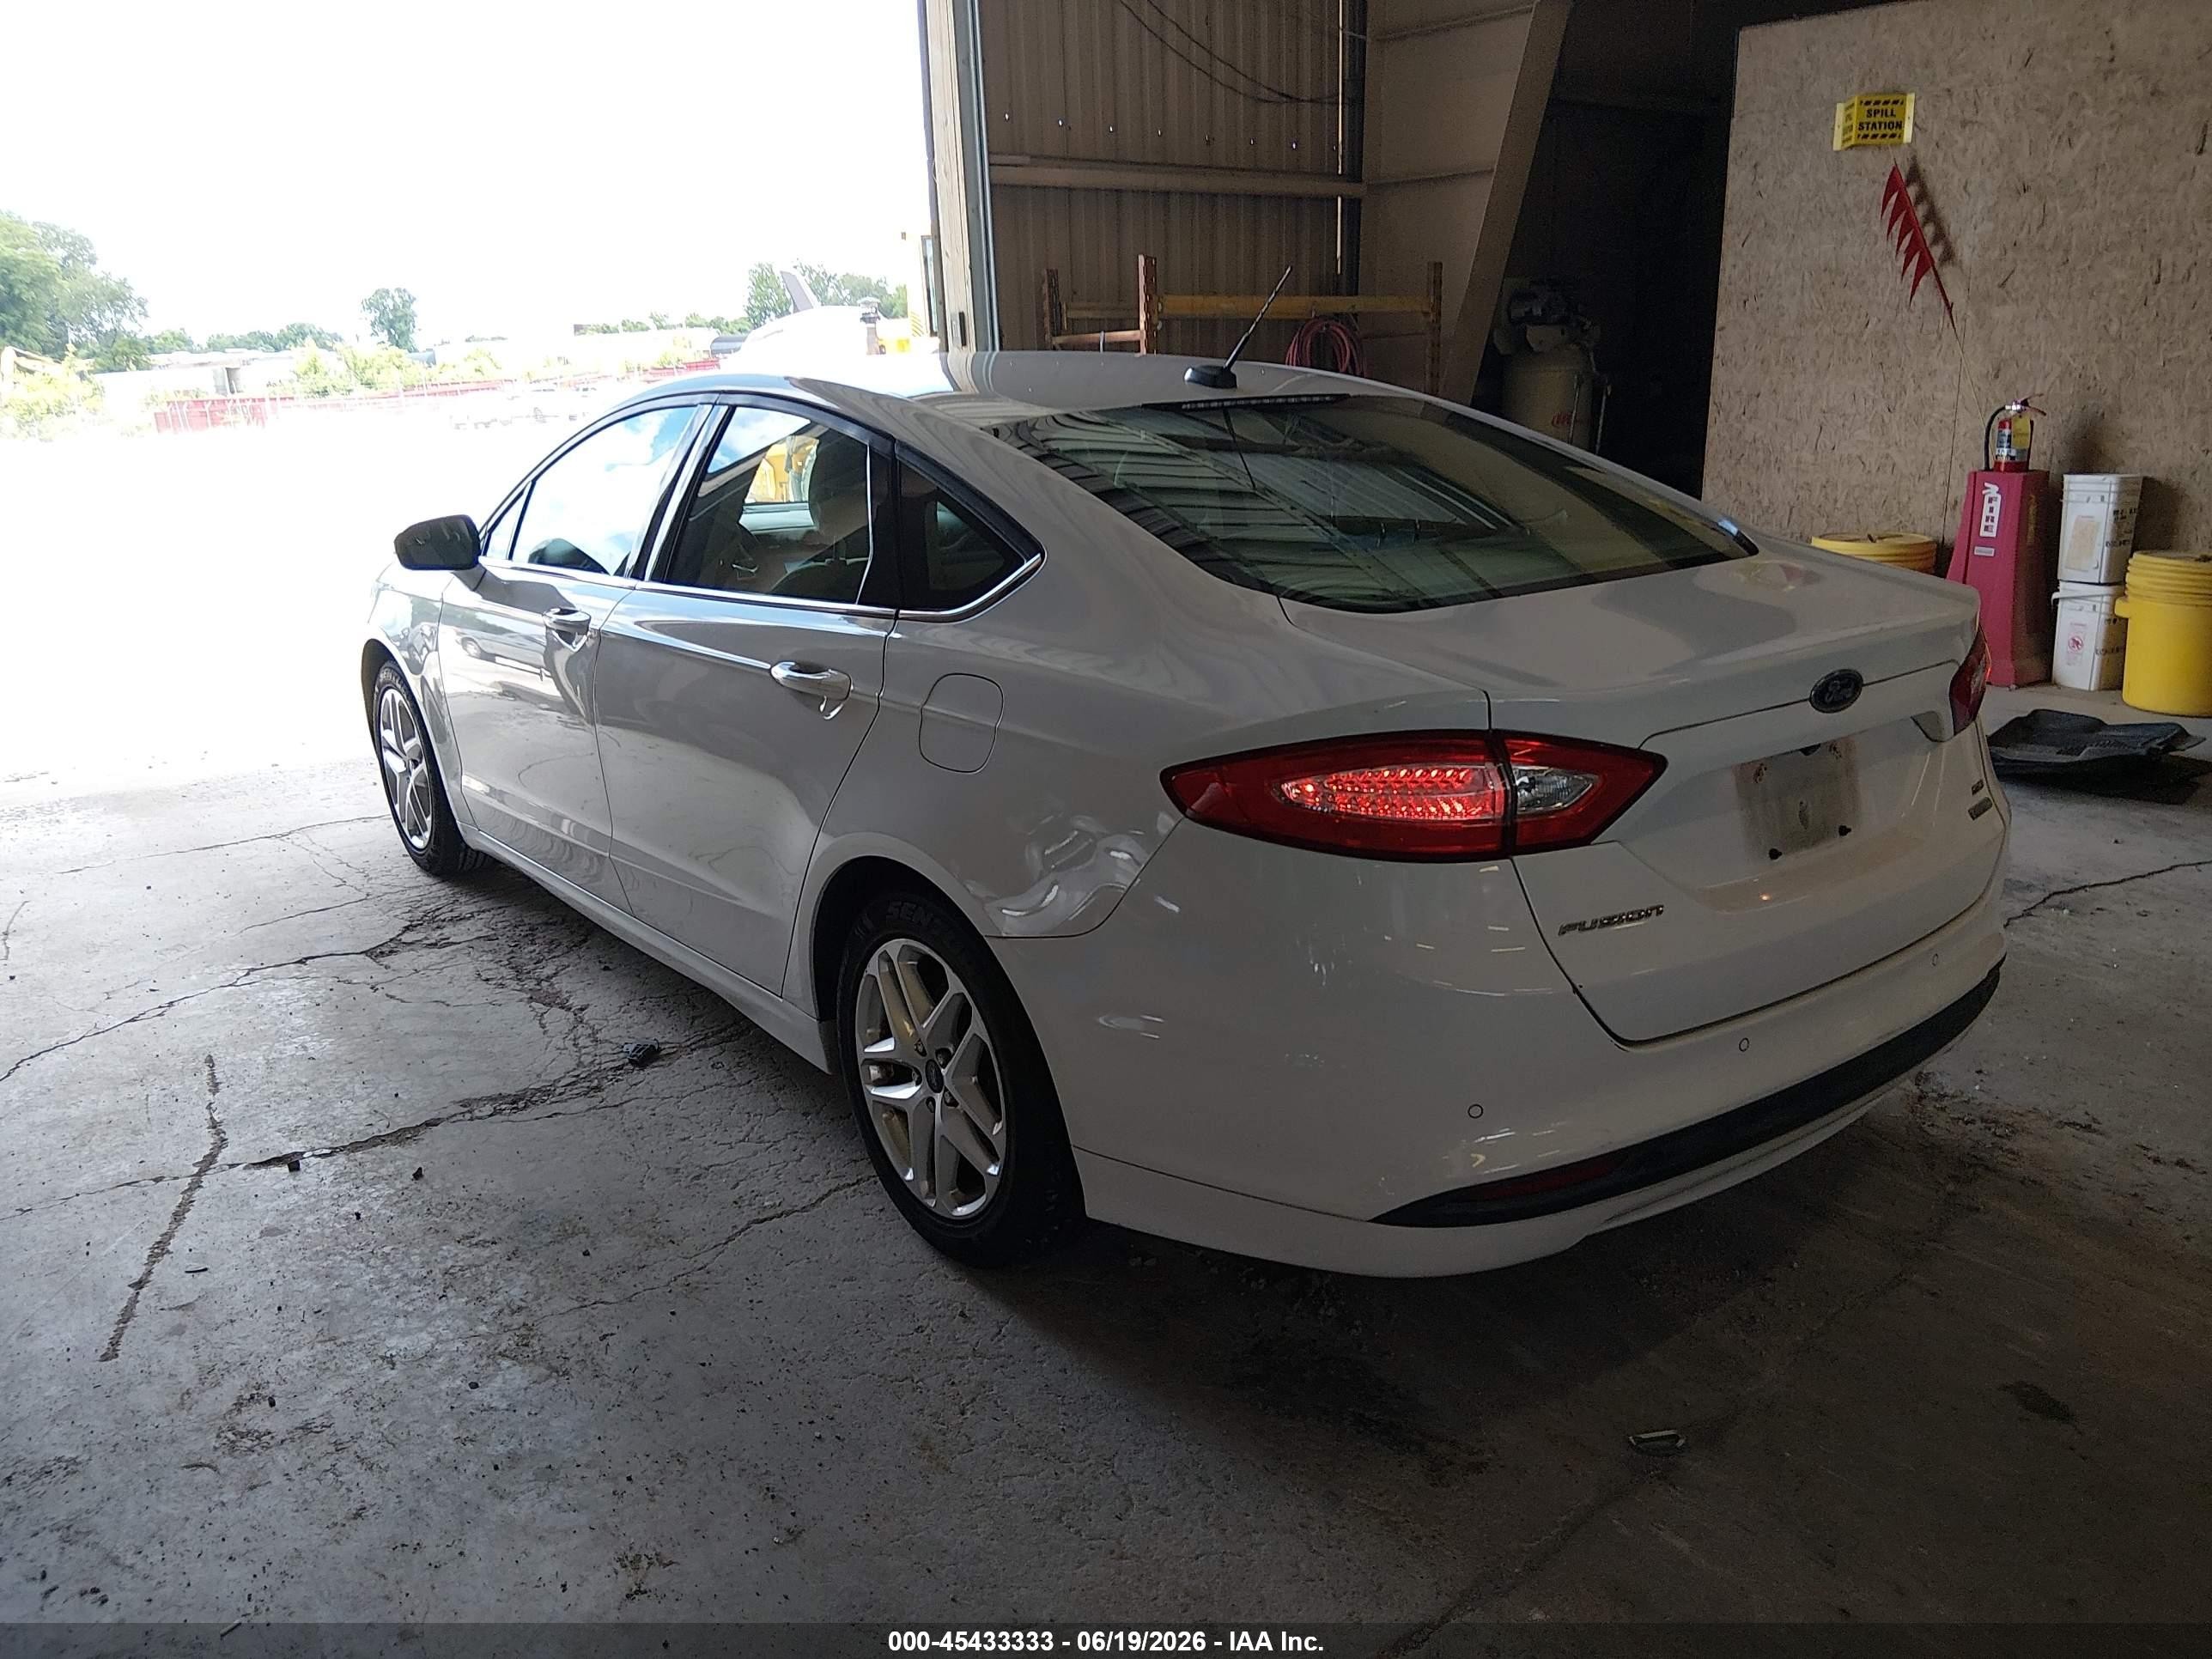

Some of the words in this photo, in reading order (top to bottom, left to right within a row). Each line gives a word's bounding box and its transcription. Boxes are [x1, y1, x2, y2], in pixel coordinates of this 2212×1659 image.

[1866, 108, 1896, 118] SPILL
[1857, 120, 1902, 131] STATION
[1984, 496, 1998, 532] FIRE
[1558, 905, 1664, 936] FUSION
